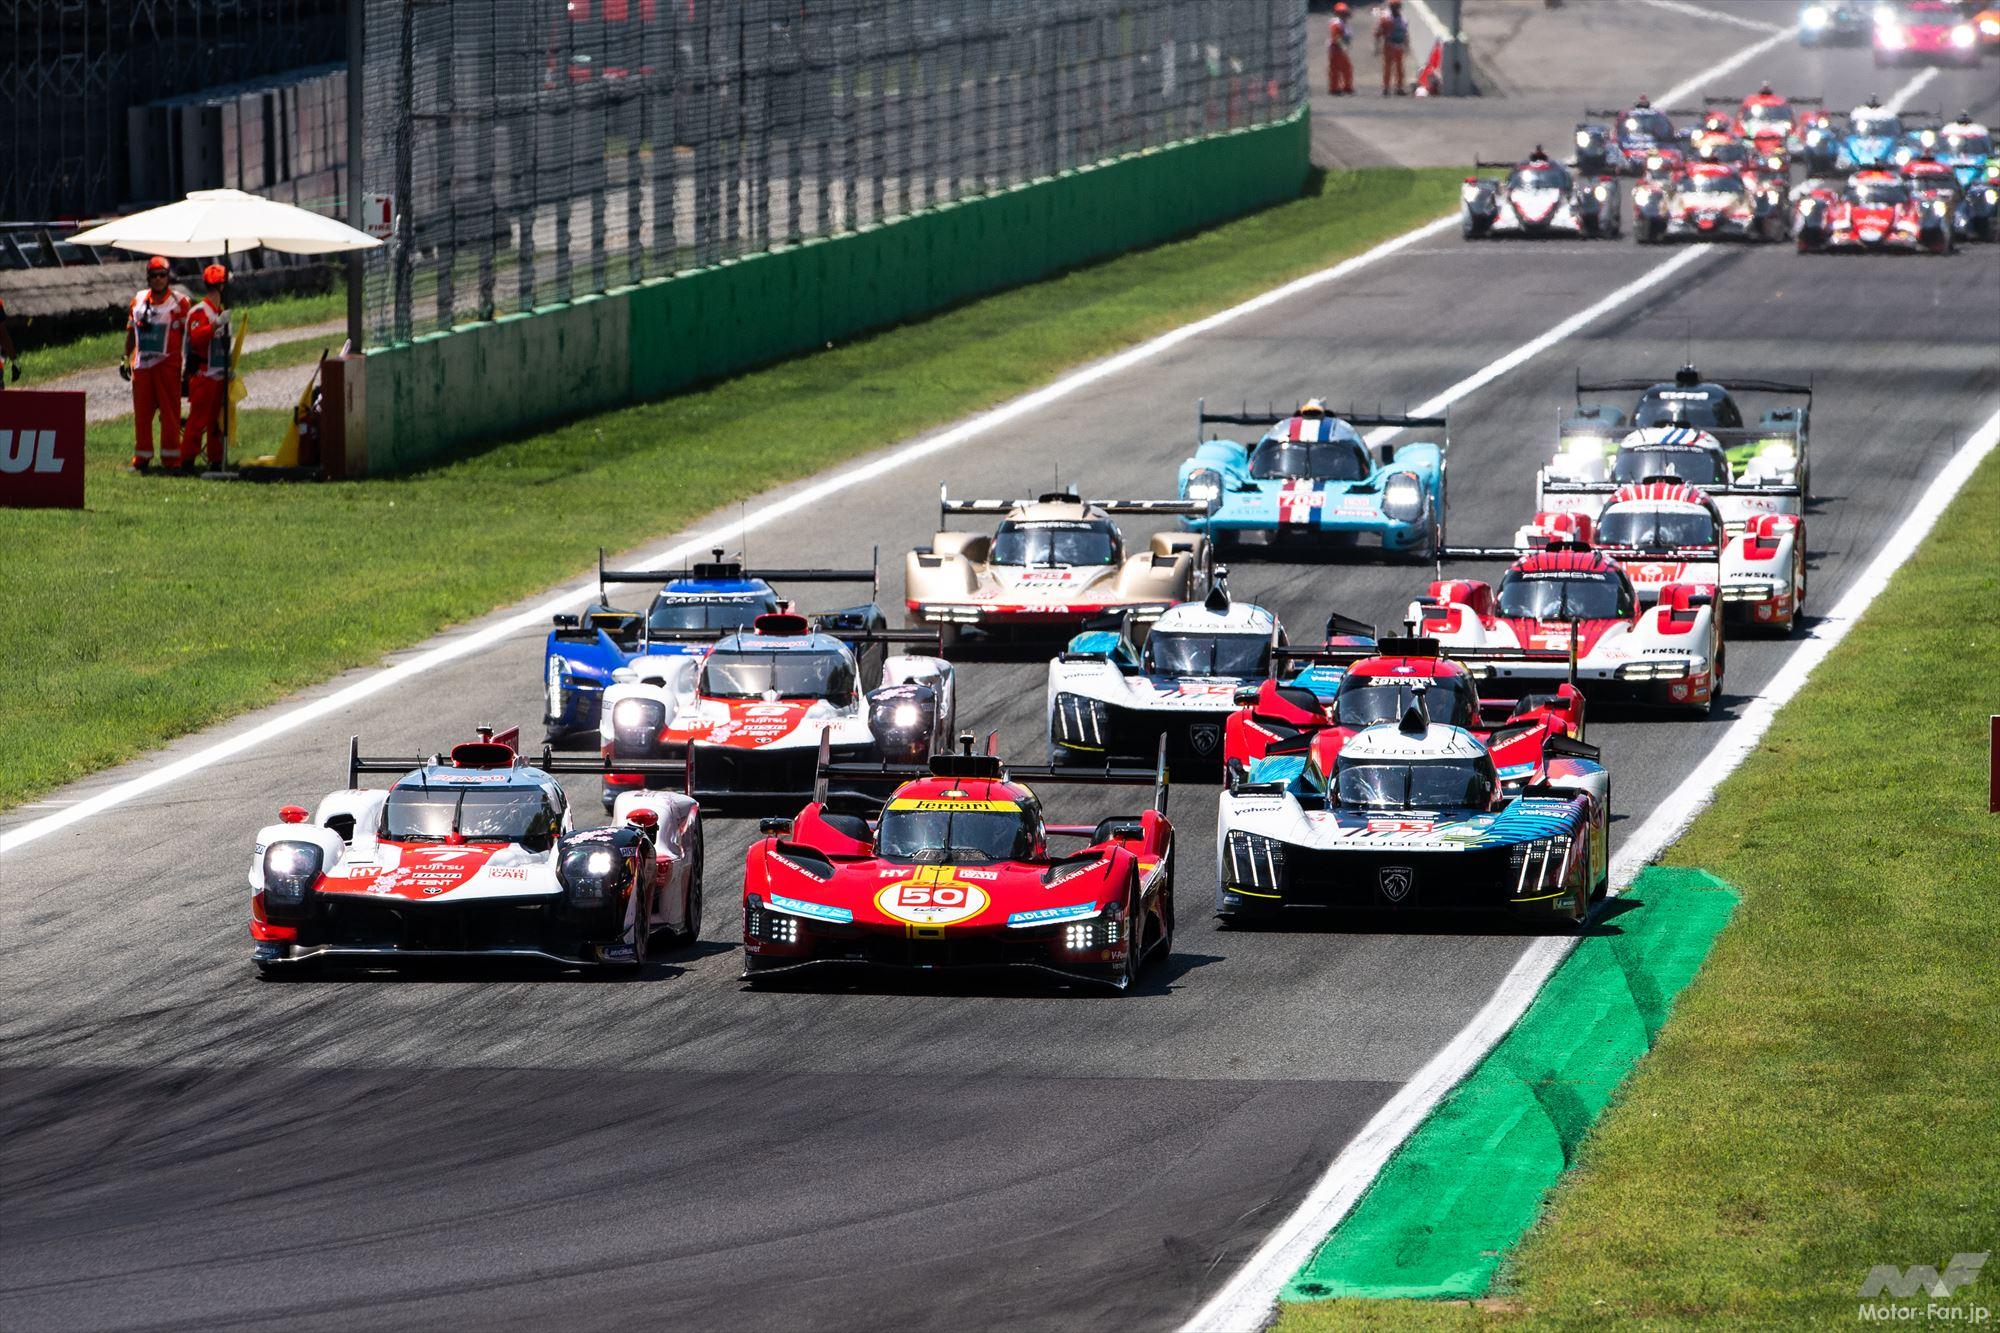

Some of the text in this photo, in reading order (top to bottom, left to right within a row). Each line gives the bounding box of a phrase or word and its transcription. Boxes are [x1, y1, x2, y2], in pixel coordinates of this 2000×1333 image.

[0, 429, 65, 474] UL
[1522, 572, 1605, 581] PORSCHE
[667, 597, 754, 605] CADILLAC
[1351, 745, 1468, 755] PEUGEOT
[915, 800, 990, 810] Ferrari
[1371, 822, 1431, 832] 93
[422, 851, 470, 862] 7
[415, 862, 465, 870] FUJITSU
[767, 850, 826, 884] RICHARD MILLE
[350, 867, 382, 878] HY
[880, 869, 911, 878] HY
[1044, 858, 1111, 890] RICHARD MILLE
[902, 887, 964, 906] 50
[776, 900, 820, 912] ADLER
[1014, 909, 1060, 922] ADLER
